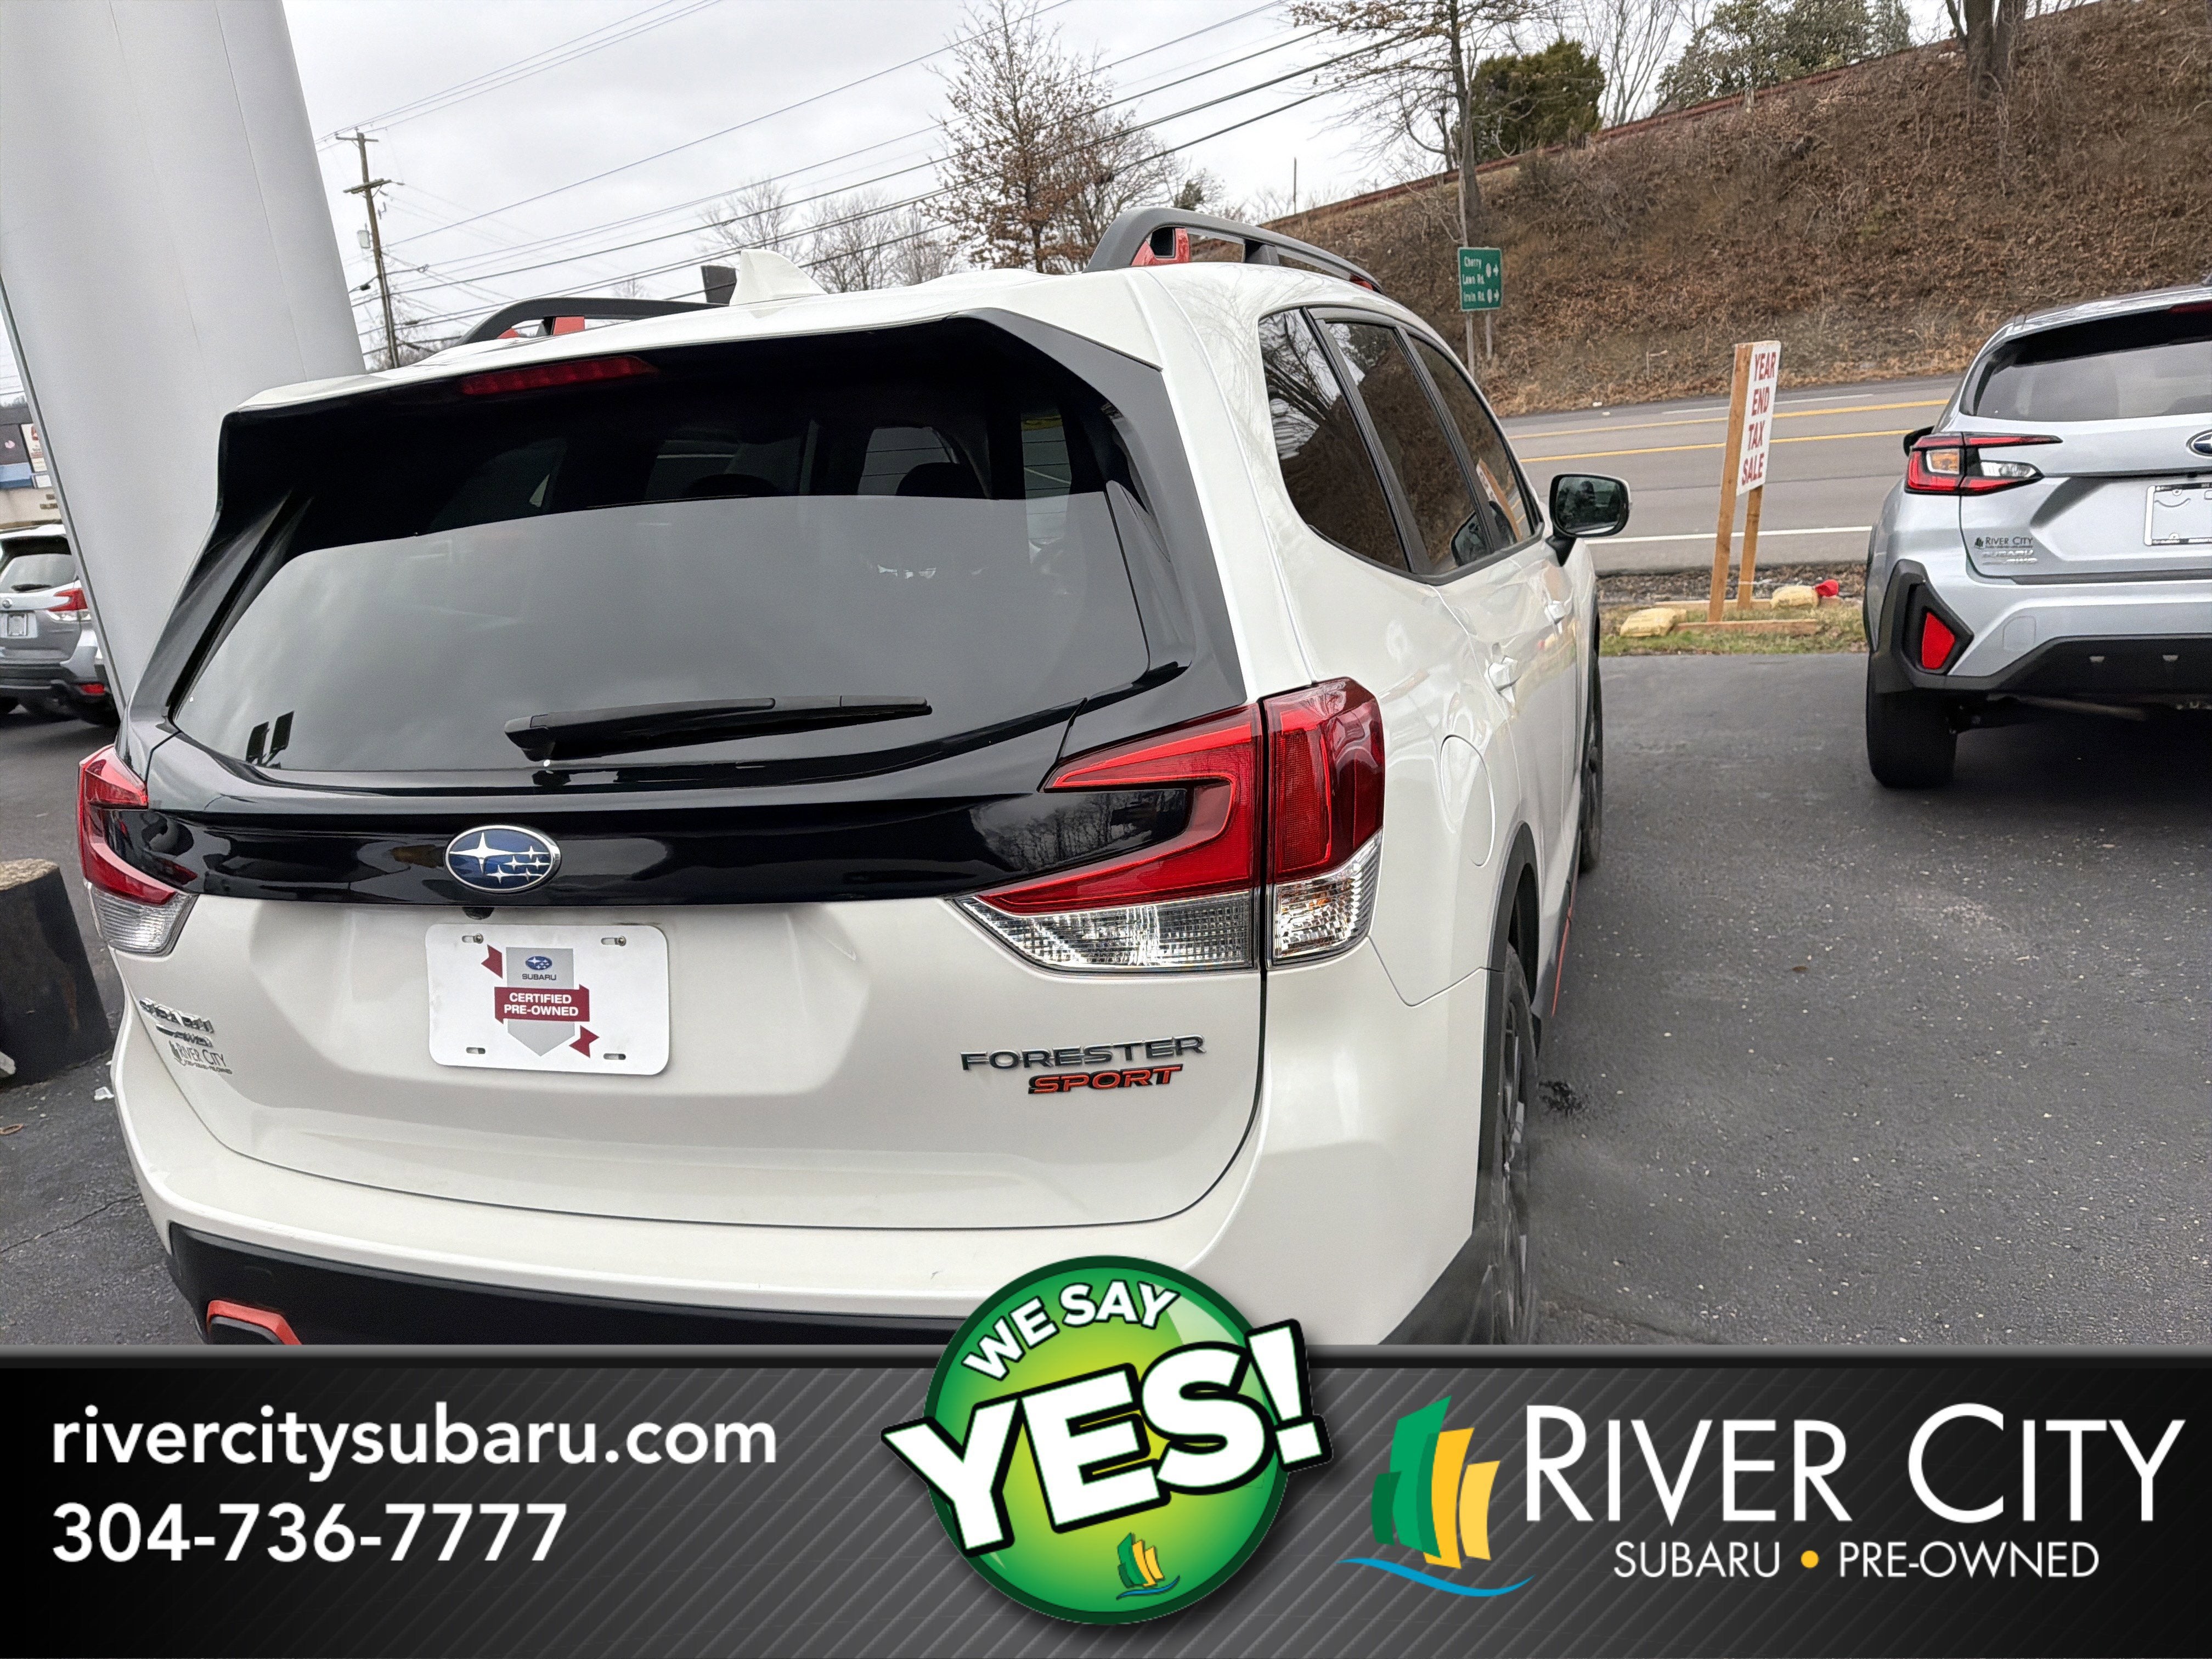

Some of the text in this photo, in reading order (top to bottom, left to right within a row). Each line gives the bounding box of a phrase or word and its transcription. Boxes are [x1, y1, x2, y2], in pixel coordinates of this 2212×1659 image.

[1754, 352, 1776, 382] YEAR
[1752, 386, 1770, 417] END
[1747, 420, 1765, 452] TAX
[1742, 453, 1765, 486] SALE
[1986, 536, 2033, 545] RIVER CITY
[504, 1004, 579, 1016] PRE-OWNED
[509, 992, 572, 1004] CERTIFIED
[175, 1042, 227, 1066] RIVER CITY
[960, 1033, 1207, 1071] FORESTER
[1028, 1063, 1183, 1094] SPORT
